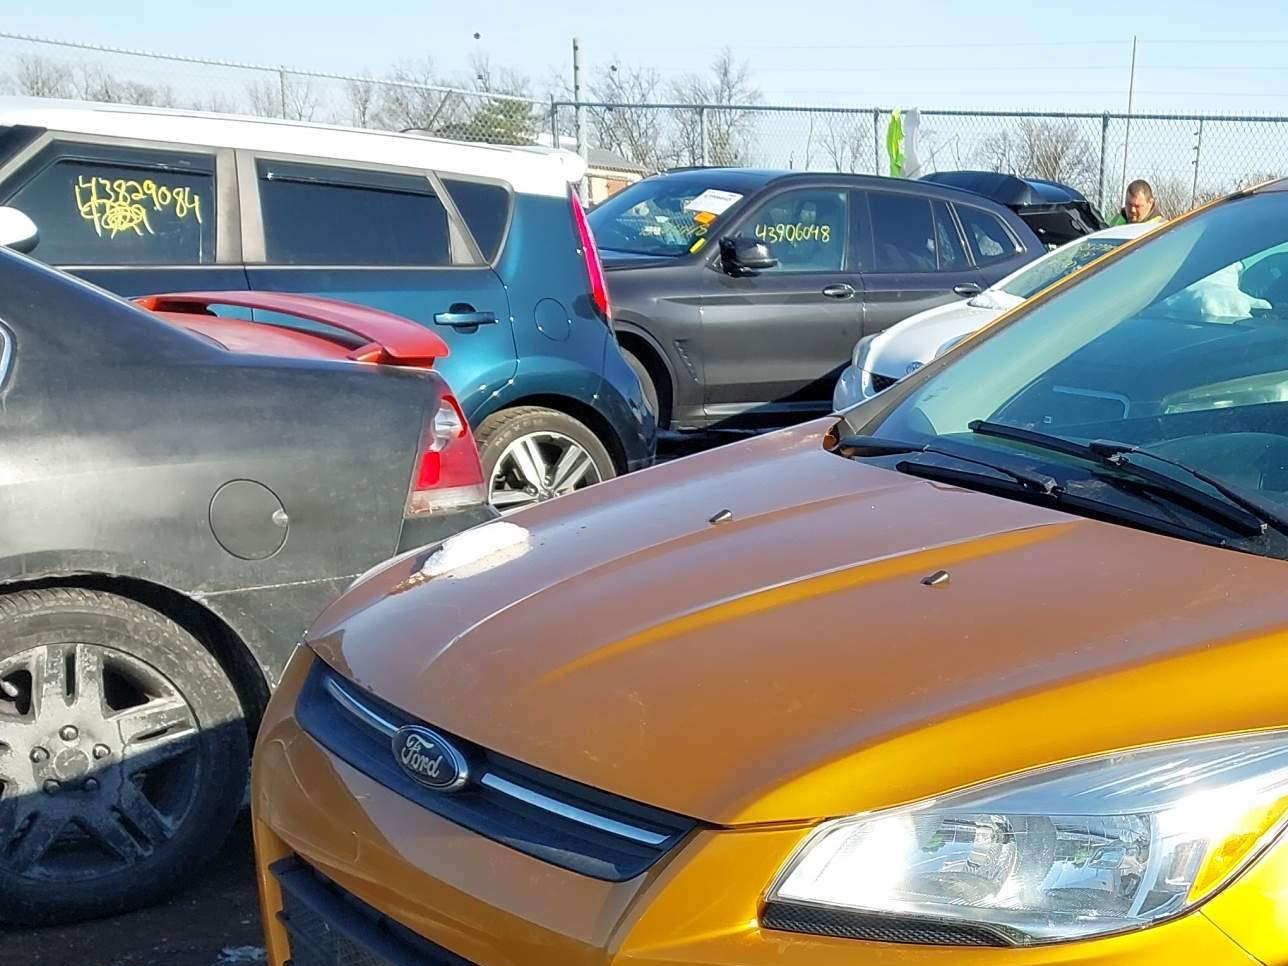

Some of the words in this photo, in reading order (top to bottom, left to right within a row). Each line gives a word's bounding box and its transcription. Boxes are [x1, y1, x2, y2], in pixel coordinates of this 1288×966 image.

[78, 175, 202, 225] 43829084
[755, 223, 832, 244] 43906048
[401, 734, 443, 777] Ford
